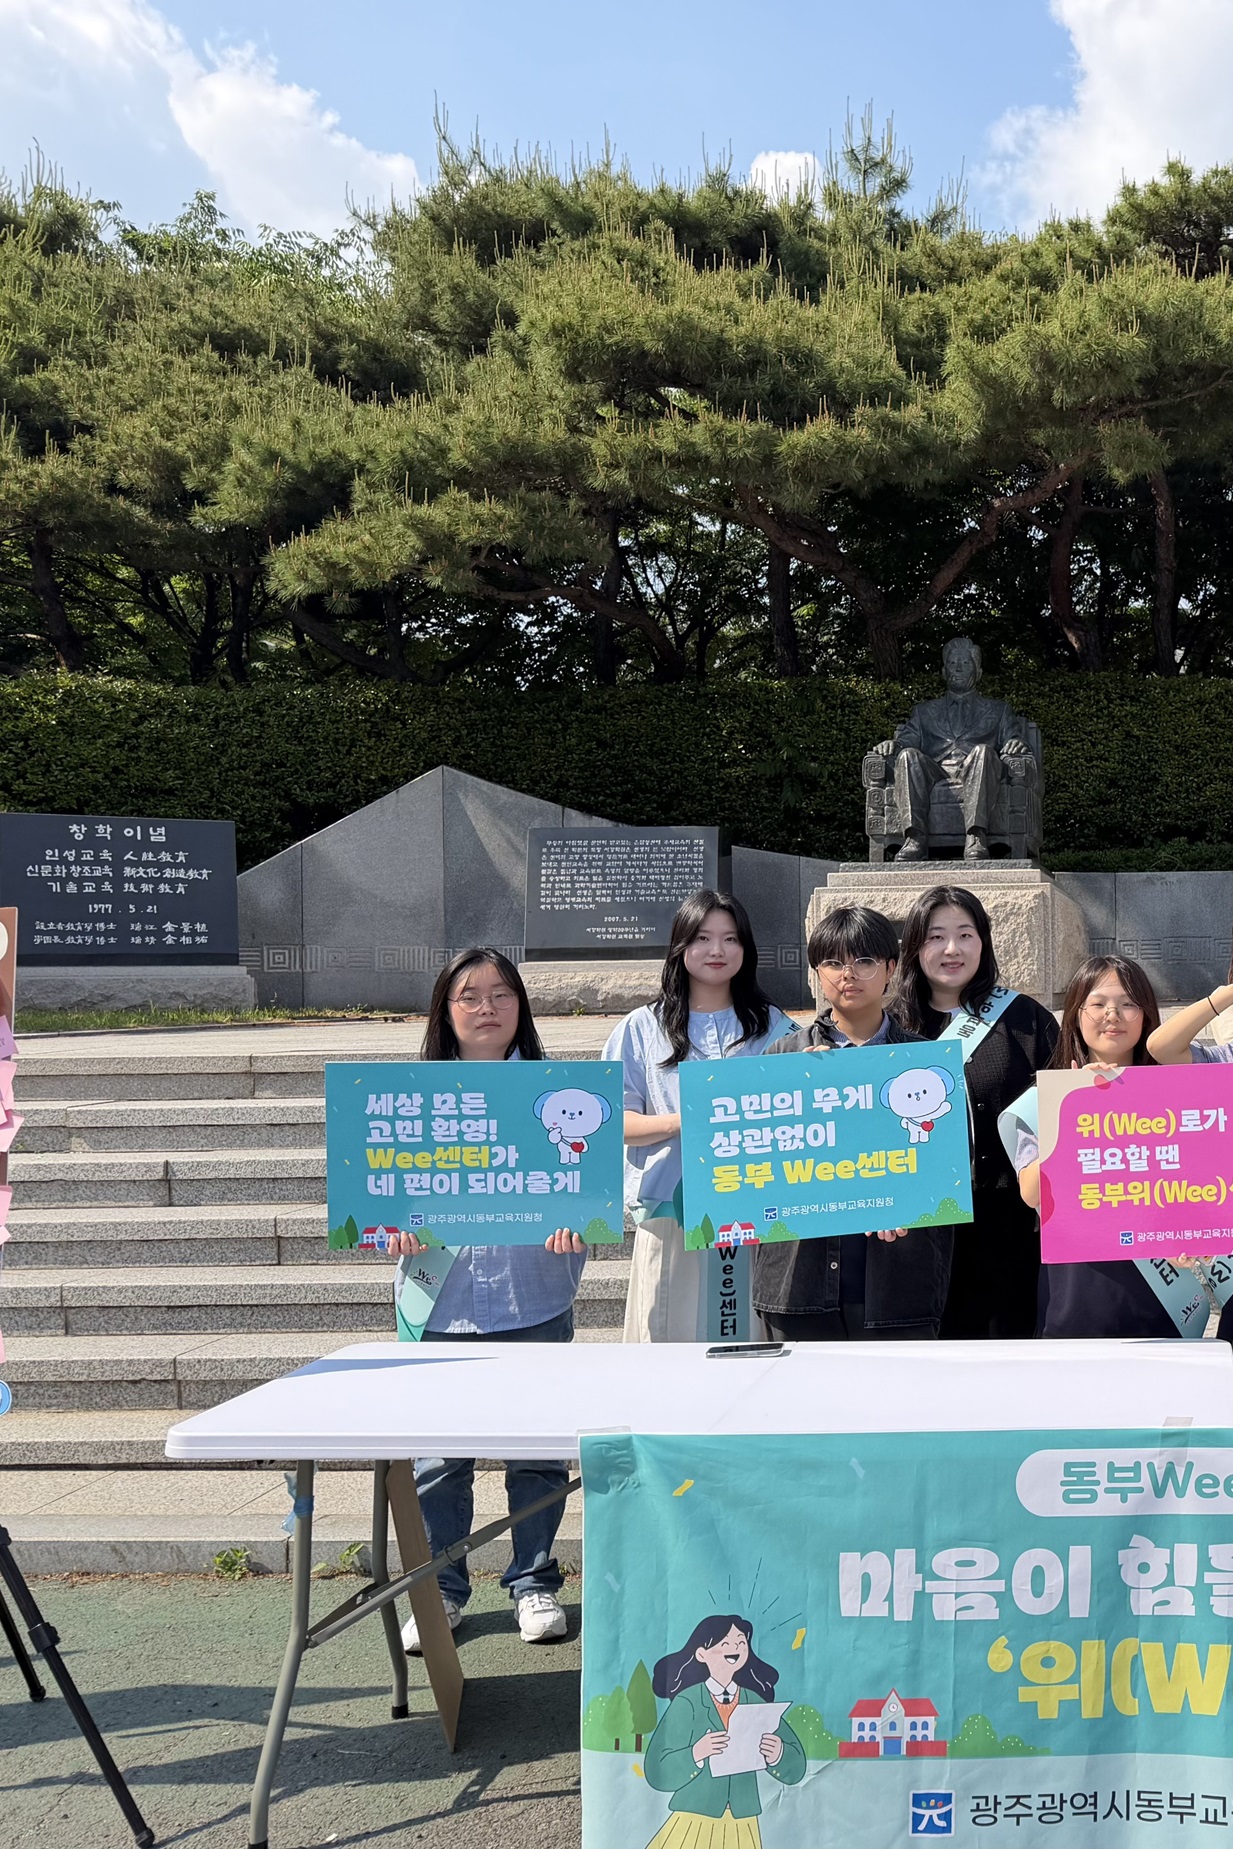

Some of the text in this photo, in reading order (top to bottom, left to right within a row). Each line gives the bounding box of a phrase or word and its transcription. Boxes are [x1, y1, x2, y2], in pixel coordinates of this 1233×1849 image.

[44, 848, 112, 862] 인성교육
[47, 881, 114, 895] 기술교육
[365, 1092, 488, 1117] 세상 모든
[709, 1083, 874, 1124] 고민의 무게
[366, 1117, 498, 1143] 고민 환영!
[709, 1120, 836, 1158] 상관없이
[366, 1145, 519, 1169] Wee센터가
[711, 1147, 918, 1193] 동부 Wee센터
[1077, 1144, 1181, 1174] 필요할 땐
[367, 1170, 581, 1197] 네 편이 되어줄게
[427, 1212, 543, 1225] 광주광역시동부교육지원청
[781, 1195, 894, 1217] 광주광역시동부교육지원청
[838, 1545, 1092, 1622] 마음이
